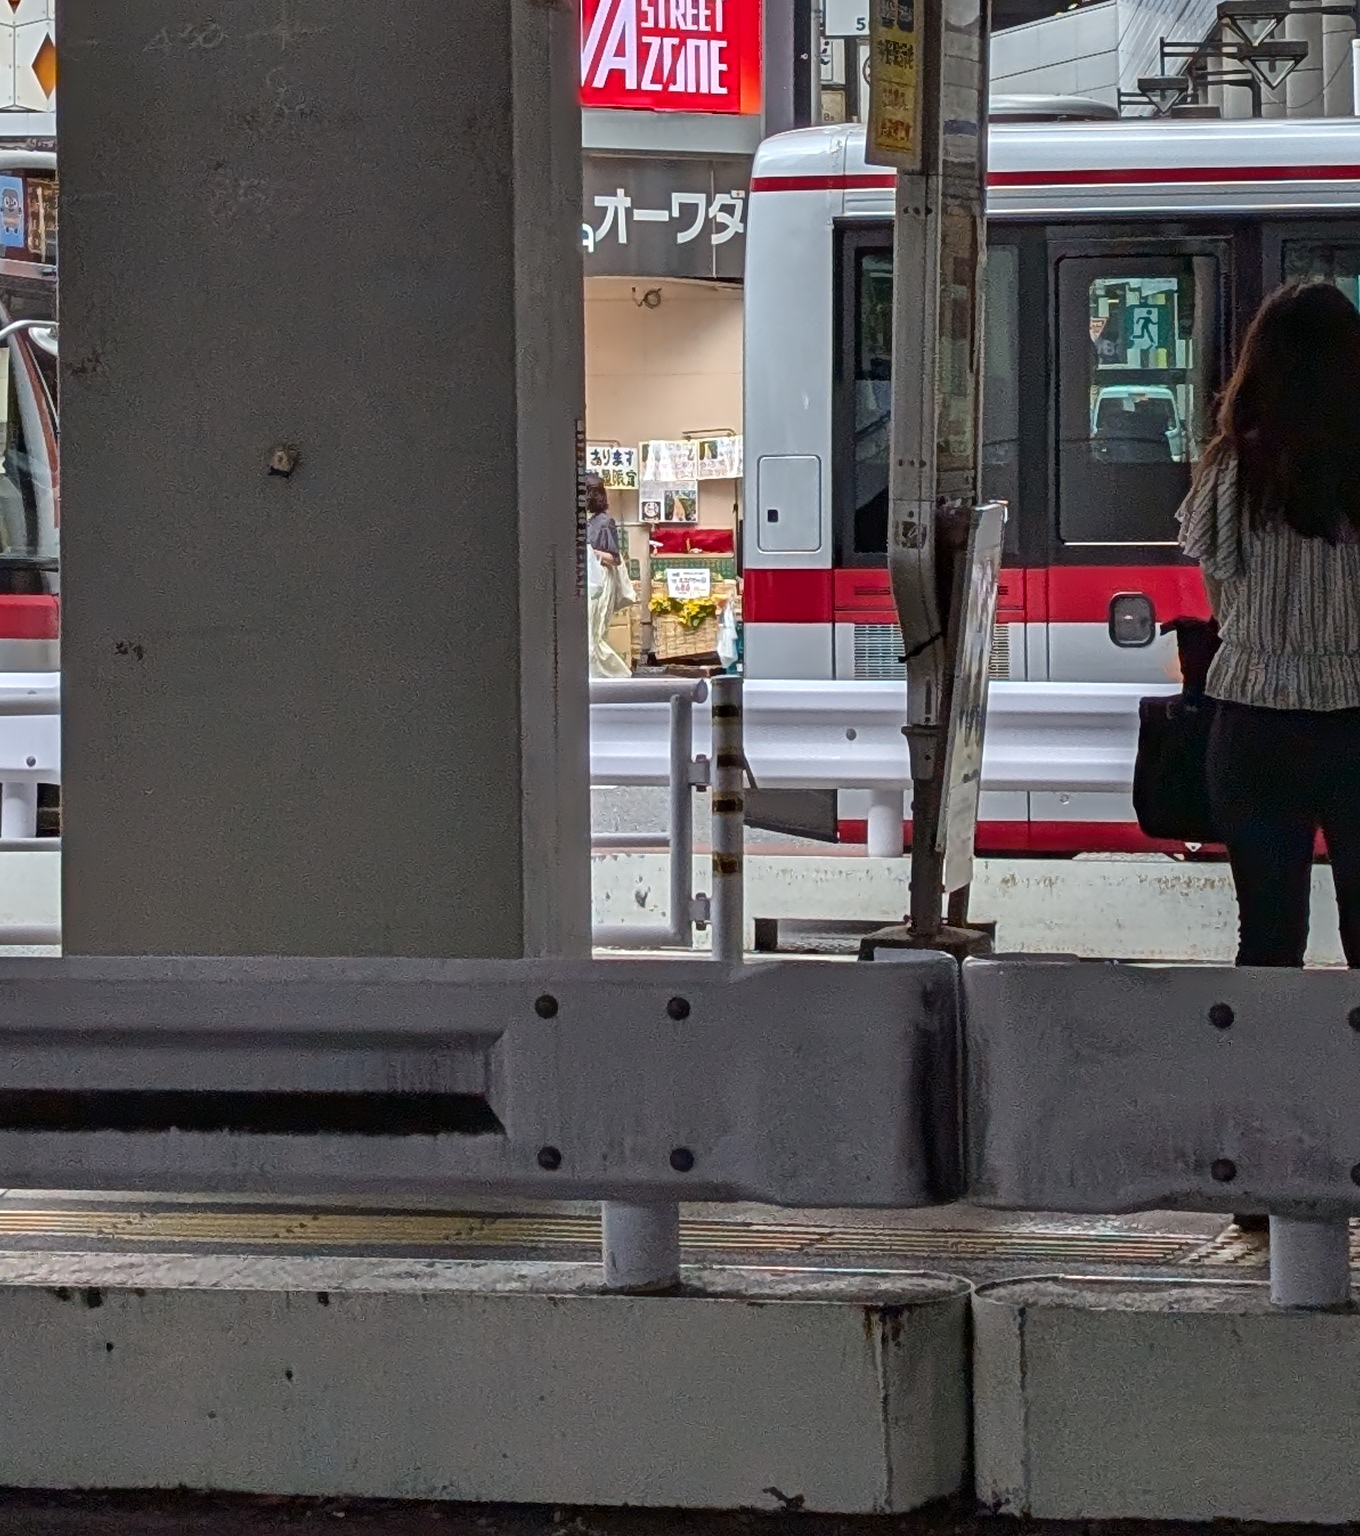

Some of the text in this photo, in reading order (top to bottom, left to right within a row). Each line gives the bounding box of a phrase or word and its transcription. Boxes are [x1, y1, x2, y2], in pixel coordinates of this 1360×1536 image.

[640, 36, 729, 95] ZONE
[593, 188, 746, 245] オーワダ
[590, 468, 638, 488] 量限定
